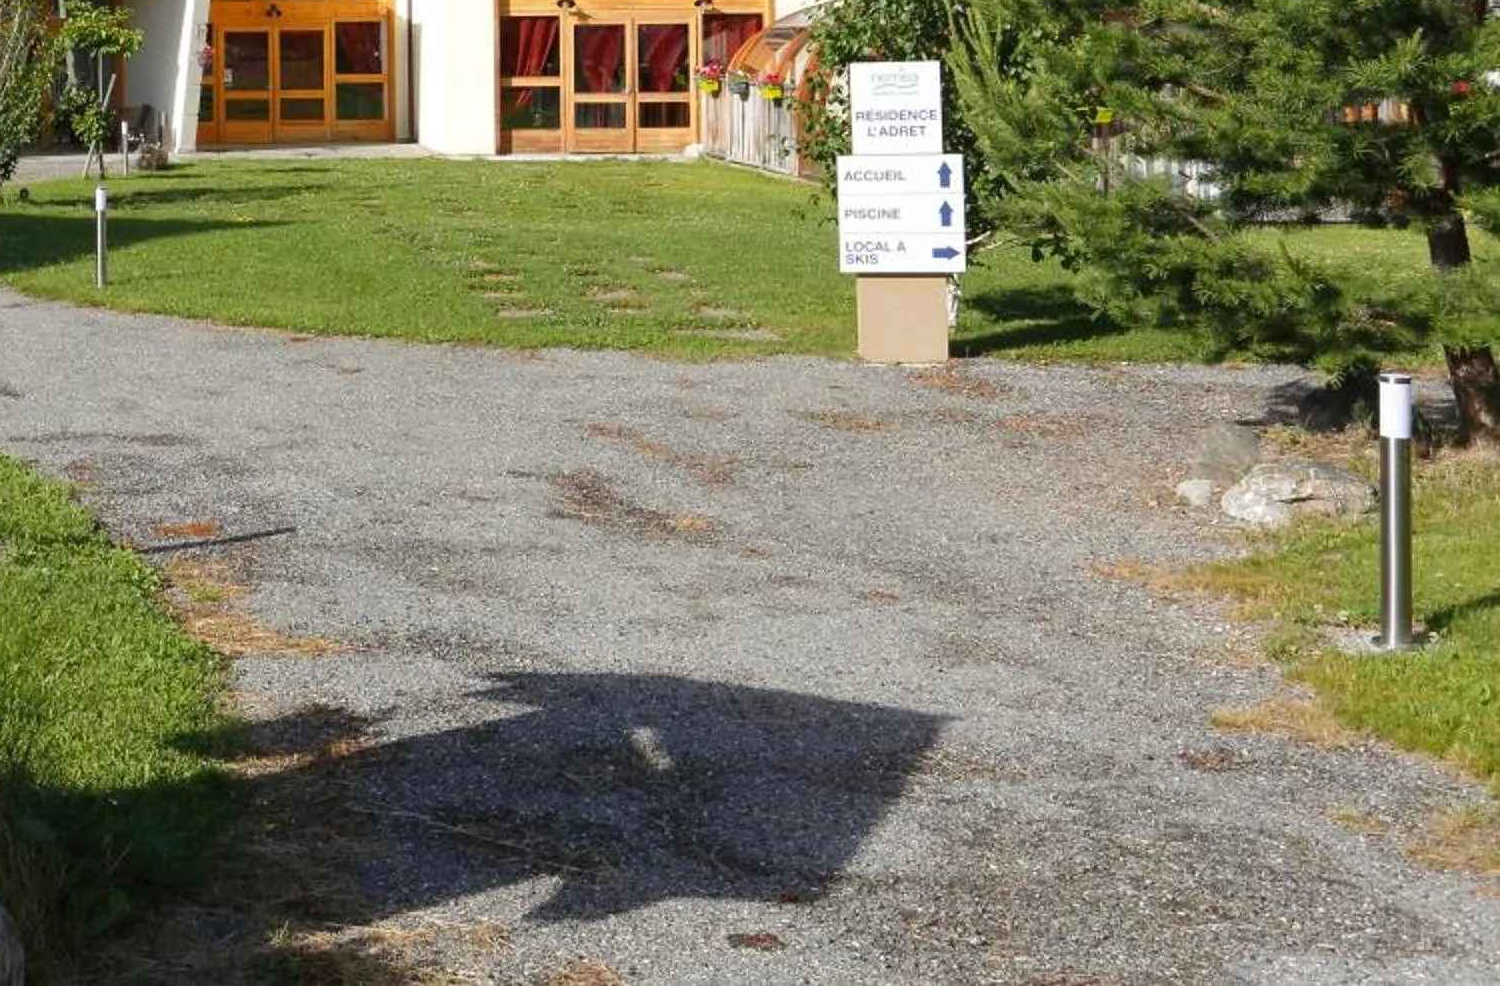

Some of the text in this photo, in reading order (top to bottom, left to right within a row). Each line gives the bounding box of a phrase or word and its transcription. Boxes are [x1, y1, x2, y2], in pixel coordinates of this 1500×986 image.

[867, 125, 927, 137] L'ADRET
[843, 170, 906, 182] ACCUEIL
[844, 208, 901, 220] PISCINE
[845, 241, 891, 252] LOCAL
[845, 253, 879, 265] SKIS
